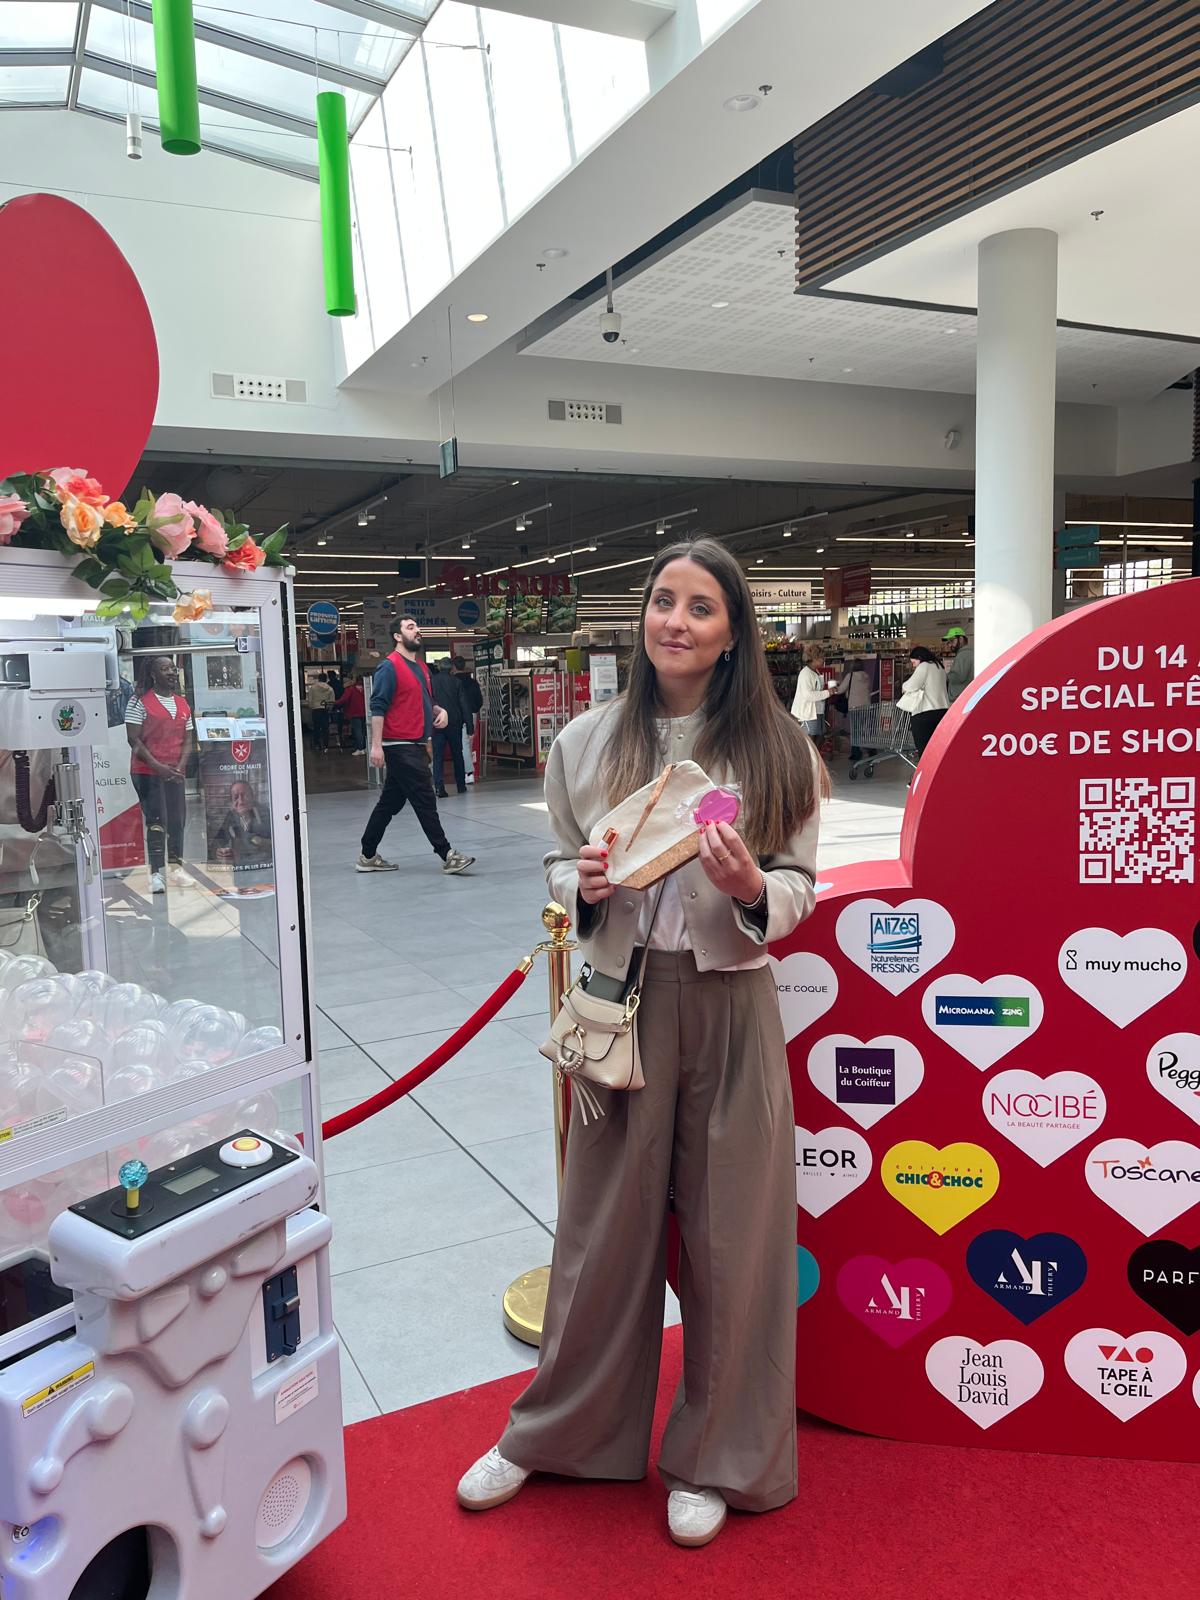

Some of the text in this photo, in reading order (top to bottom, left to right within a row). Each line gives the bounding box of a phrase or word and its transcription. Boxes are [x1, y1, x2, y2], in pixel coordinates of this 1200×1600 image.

[751, 589, 772, 598] oisirs
[778, 589, 806, 597] Culture
[848, 611, 903, 628] ARDIN
[1098, 645, 1187, 671] DU 14
[1021, 679, 1155, 711] SPÉCIAL
[981, 733, 1058, 757] 200€
[1069, 730, 1111, 755] DE
[870, 955, 919, 963] Naturellement
[1085, 958, 1181, 972] muy mucho
[870, 963, 920, 973] PRESSING
[794, 985, 828, 993] COQUE
[939, 1005, 995, 1015] MICROMANIA
[839, 1066, 892, 1077] La Boutique
[840, 1078, 891, 1087] du Coiffeur
[991, 1090, 1097, 1119] NOCIBÉ
[796, 1148, 857, 1168] EOR
[994, 1283, 1031, 1291] ARMAND
[962, 1348, 1003, 1368] Jean
[959, 1367, 1007, 1387] Louis
[1097, 1367, 1153, 1382] TAPE À
[957, 1385, 1009, 1406] David
[1101, 1383, 1153, 1398] L'OEIL
